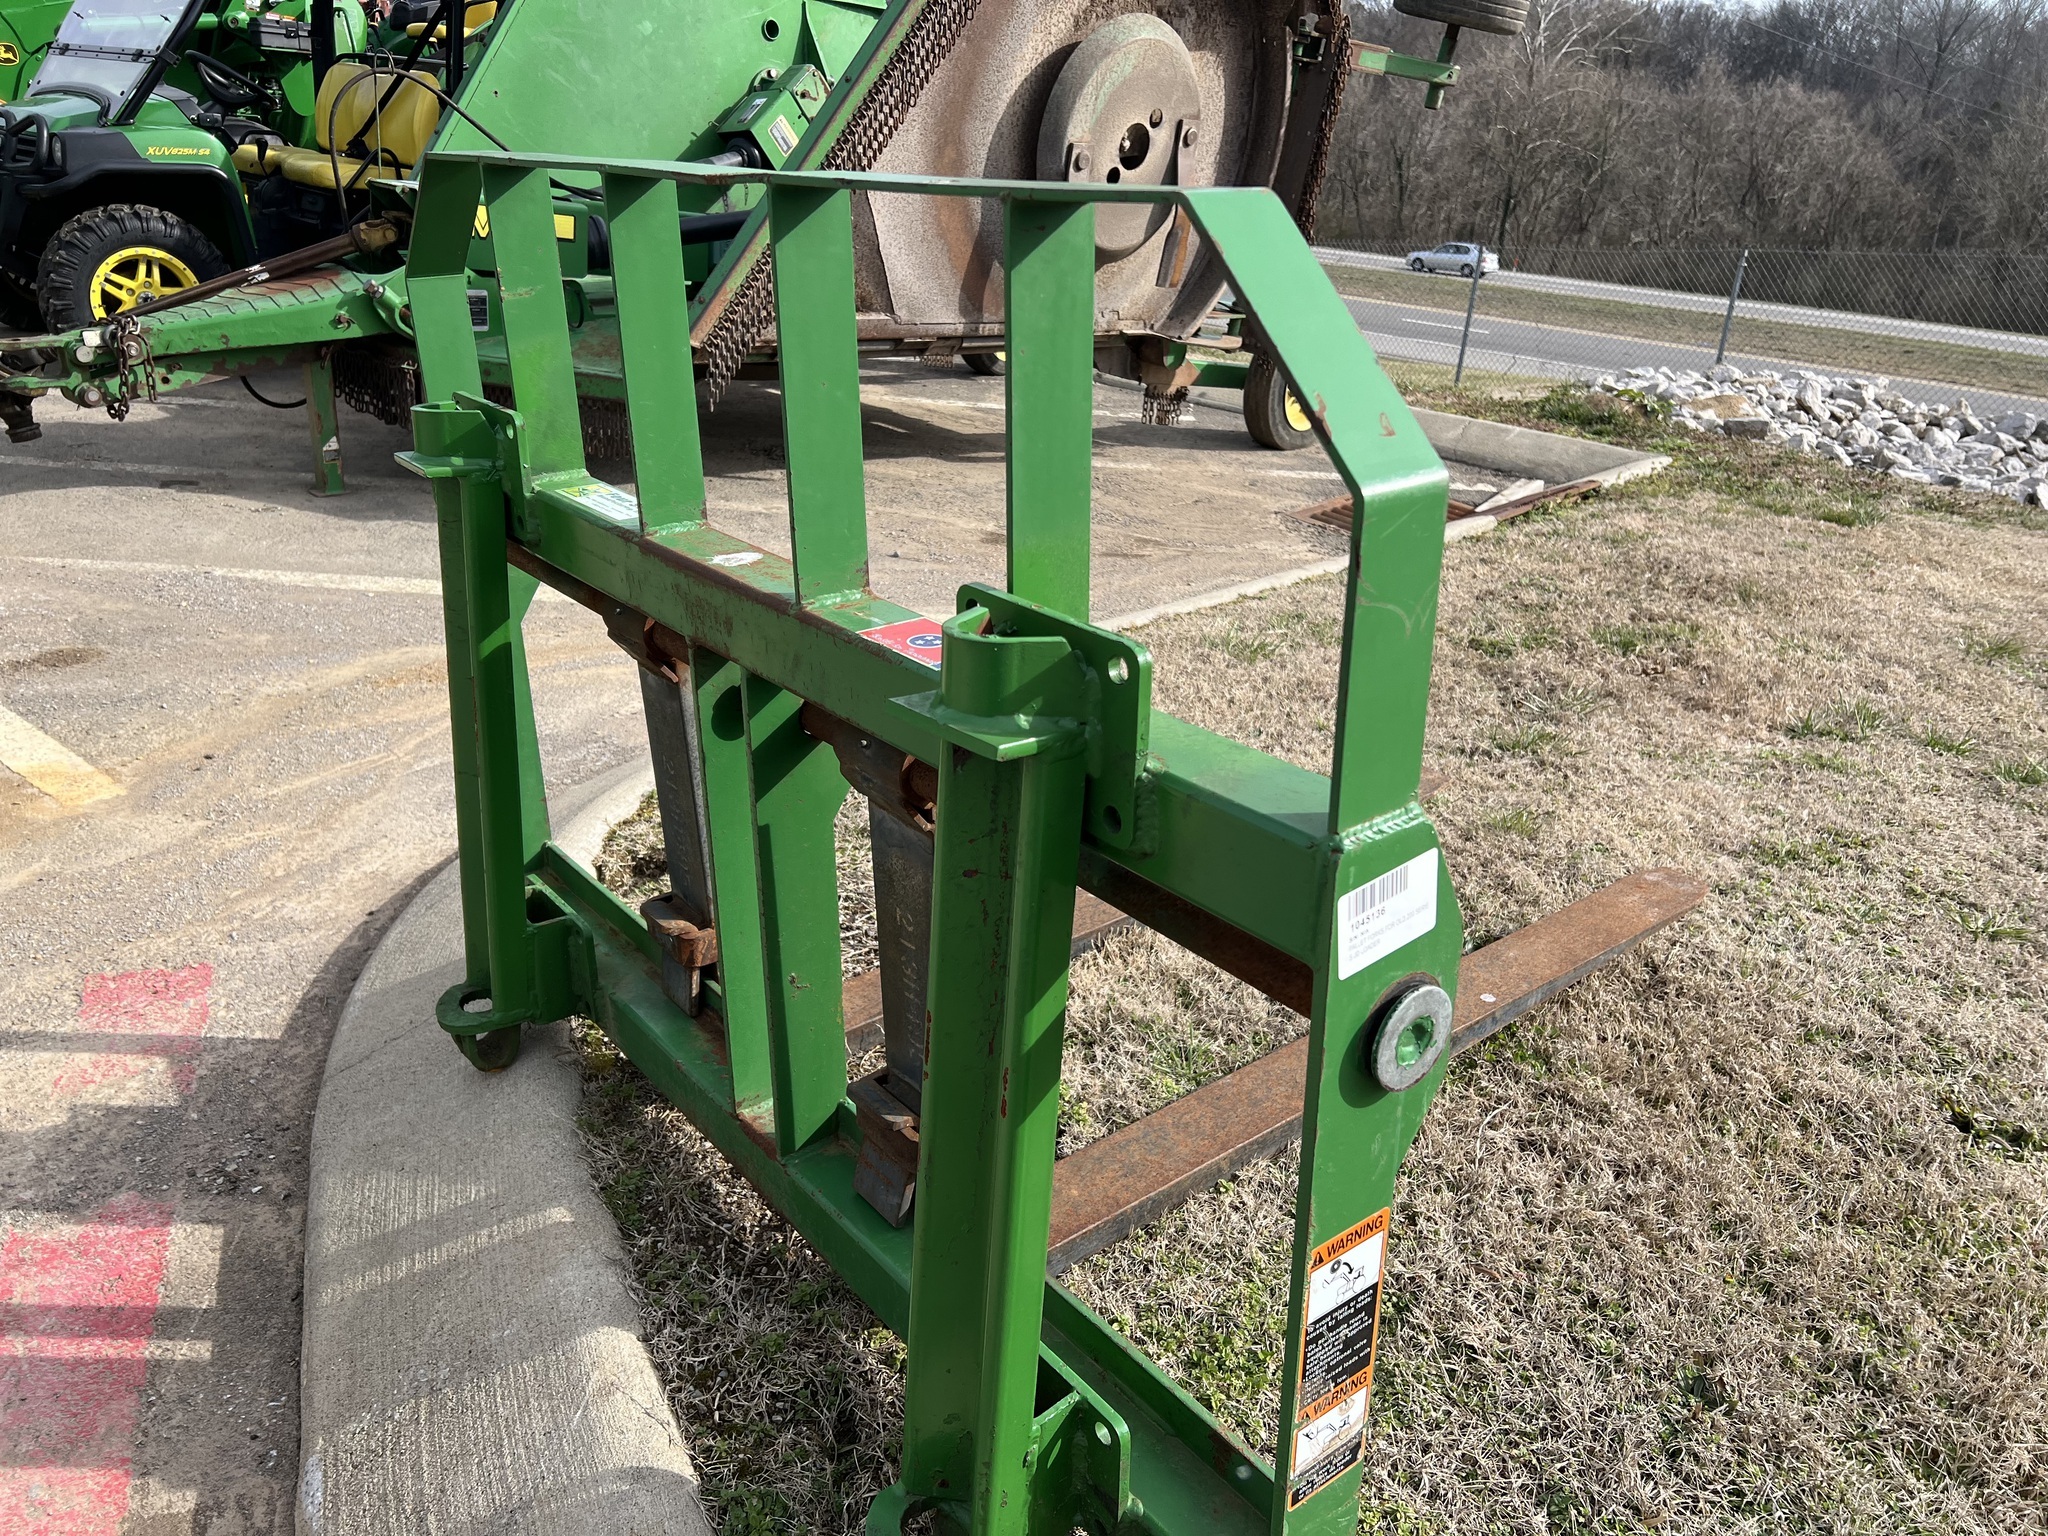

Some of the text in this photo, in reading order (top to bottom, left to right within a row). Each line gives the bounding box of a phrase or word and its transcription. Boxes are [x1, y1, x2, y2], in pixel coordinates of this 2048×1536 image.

[1351, 906, 1385, 932] 1045136
[1368, 928, 1384, 941] FORKS
[1385, 921, 1396, 931] FOR
[1327, 1215, 1383, 1258] WARNING
[1306, 1325, 1327, 1340] caused
[1338, 1308, 1355, 1320] falling
[1356, 1296, 1373, 1309] loads:
[1316, 1316, 1331, 1328] avoid
[1333, 1306, 1348, 1317] injury
[1358, 1289, 1373, 1302] death
[1330, 1323, 1347, 1336] handle
[1349, 1311, 1365, 1324] round
[1347, 1318, 1372, 1337] approved
[1325, 1348, 1371, 1379] raised loads with
[1330, 1348, 1352, 1366] optional
[1354, 1339, 1367, 1350] valve
[1313, 1372, 1367, 1415] WARNING
